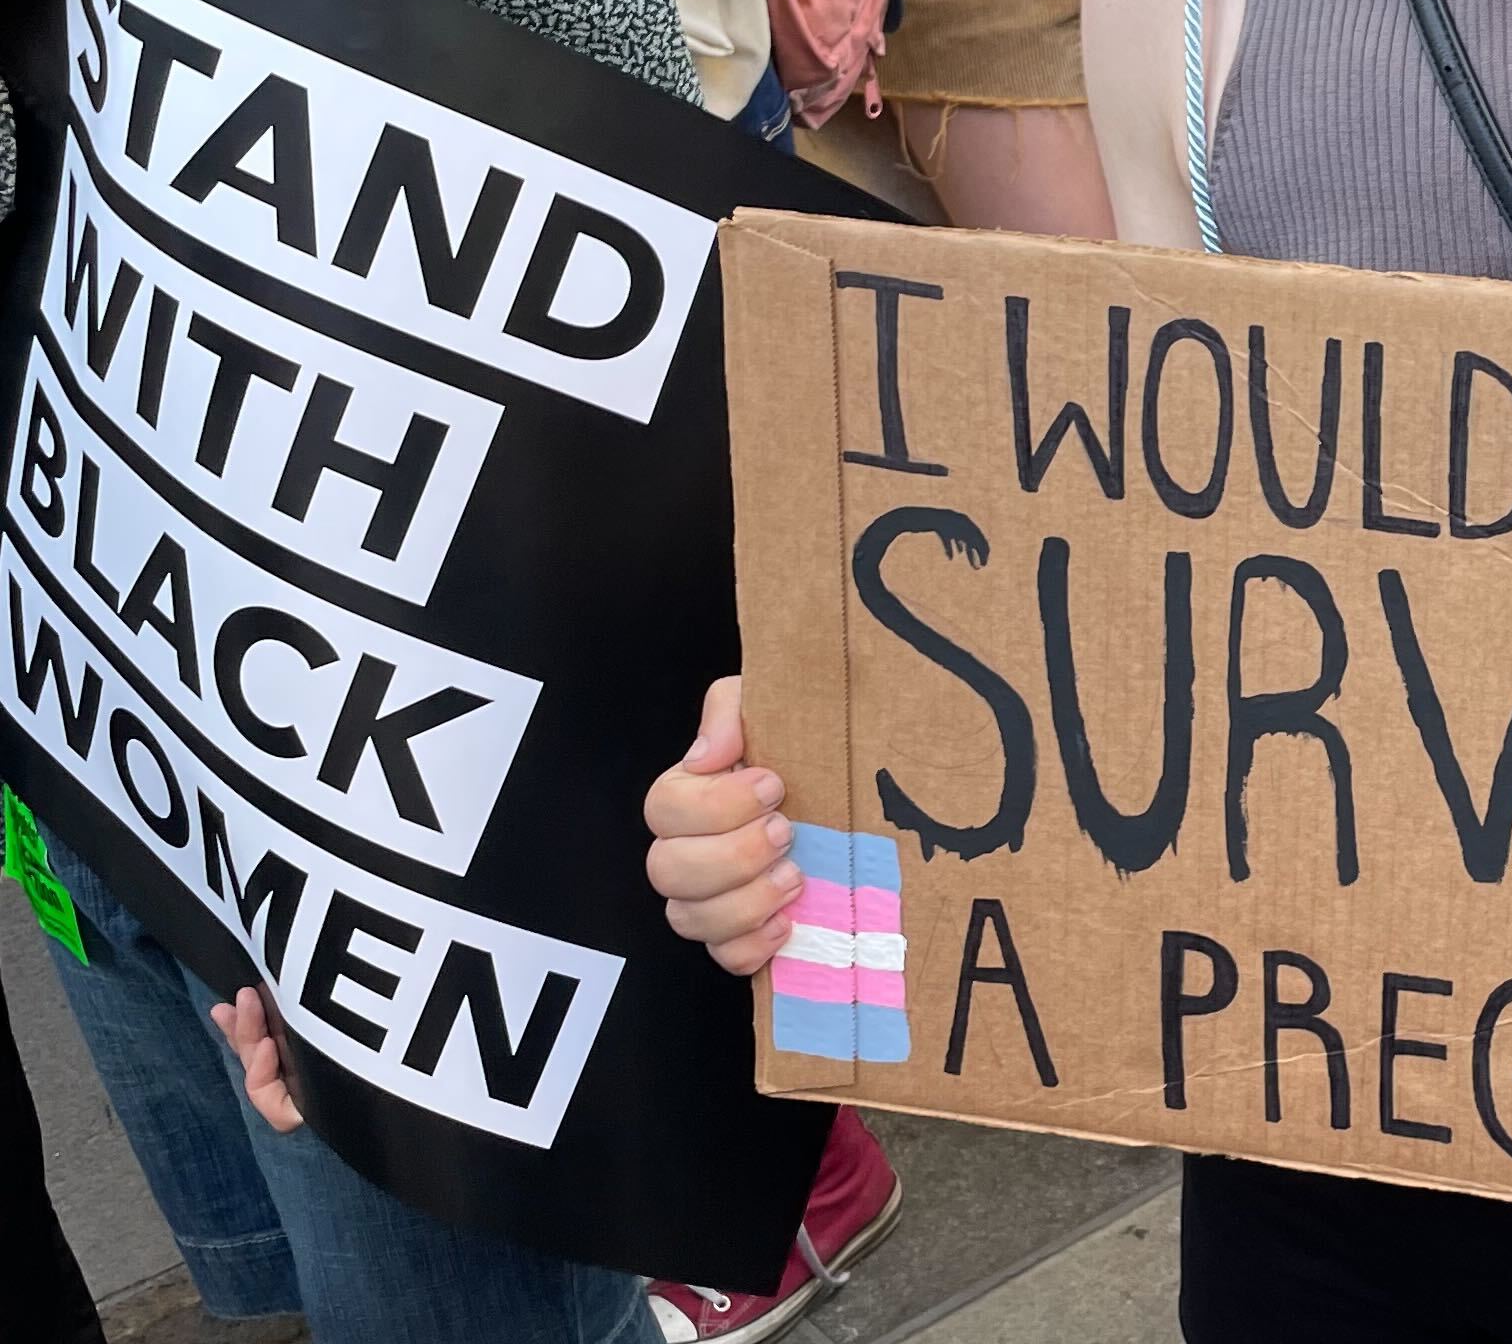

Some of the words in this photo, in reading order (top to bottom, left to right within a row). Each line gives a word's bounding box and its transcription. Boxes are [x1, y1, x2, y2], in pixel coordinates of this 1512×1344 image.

[63, 167, 452, 562] WITH
[835, 270, 949, 477] I
[19, 377, 496, 834] BLACK
[8, 568, 582, 1110] WOMEN
[943, 898, 1060, 1087] A
